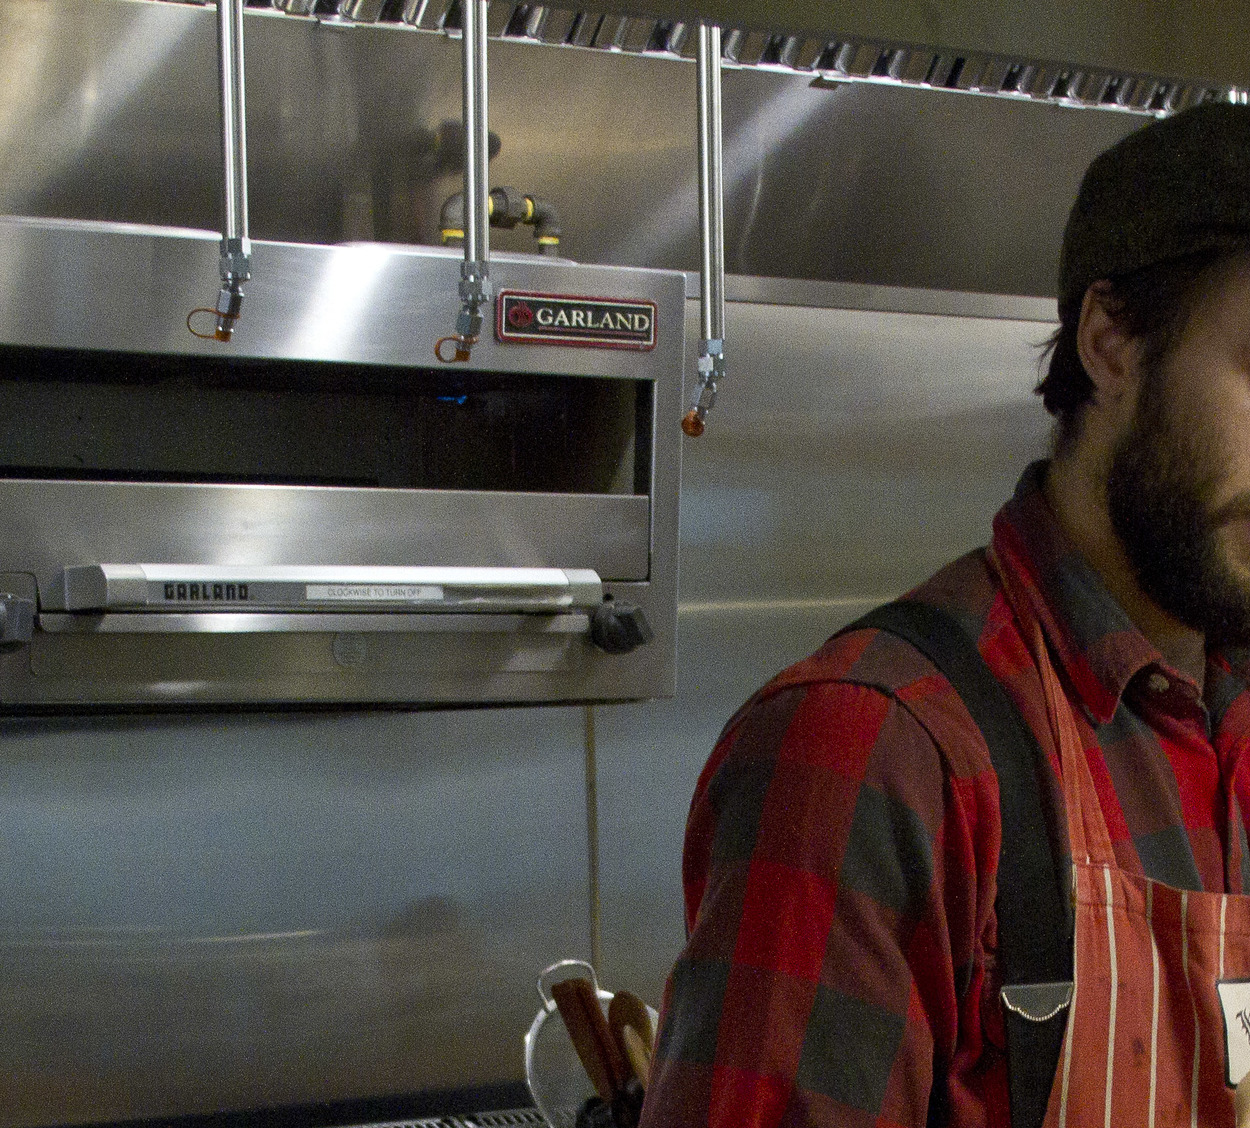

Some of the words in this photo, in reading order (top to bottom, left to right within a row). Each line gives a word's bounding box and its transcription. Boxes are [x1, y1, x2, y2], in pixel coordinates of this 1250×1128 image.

[536, 308, 650, 331] GARLAND
[164, 582, 249, 600] GARLAND
[327, 587, 371, 597] CLOCKWISE
[374, 587, 385, 597] TO
[386, 587, 406, 597] TURN
[407, 587, 422, 597] OFF
